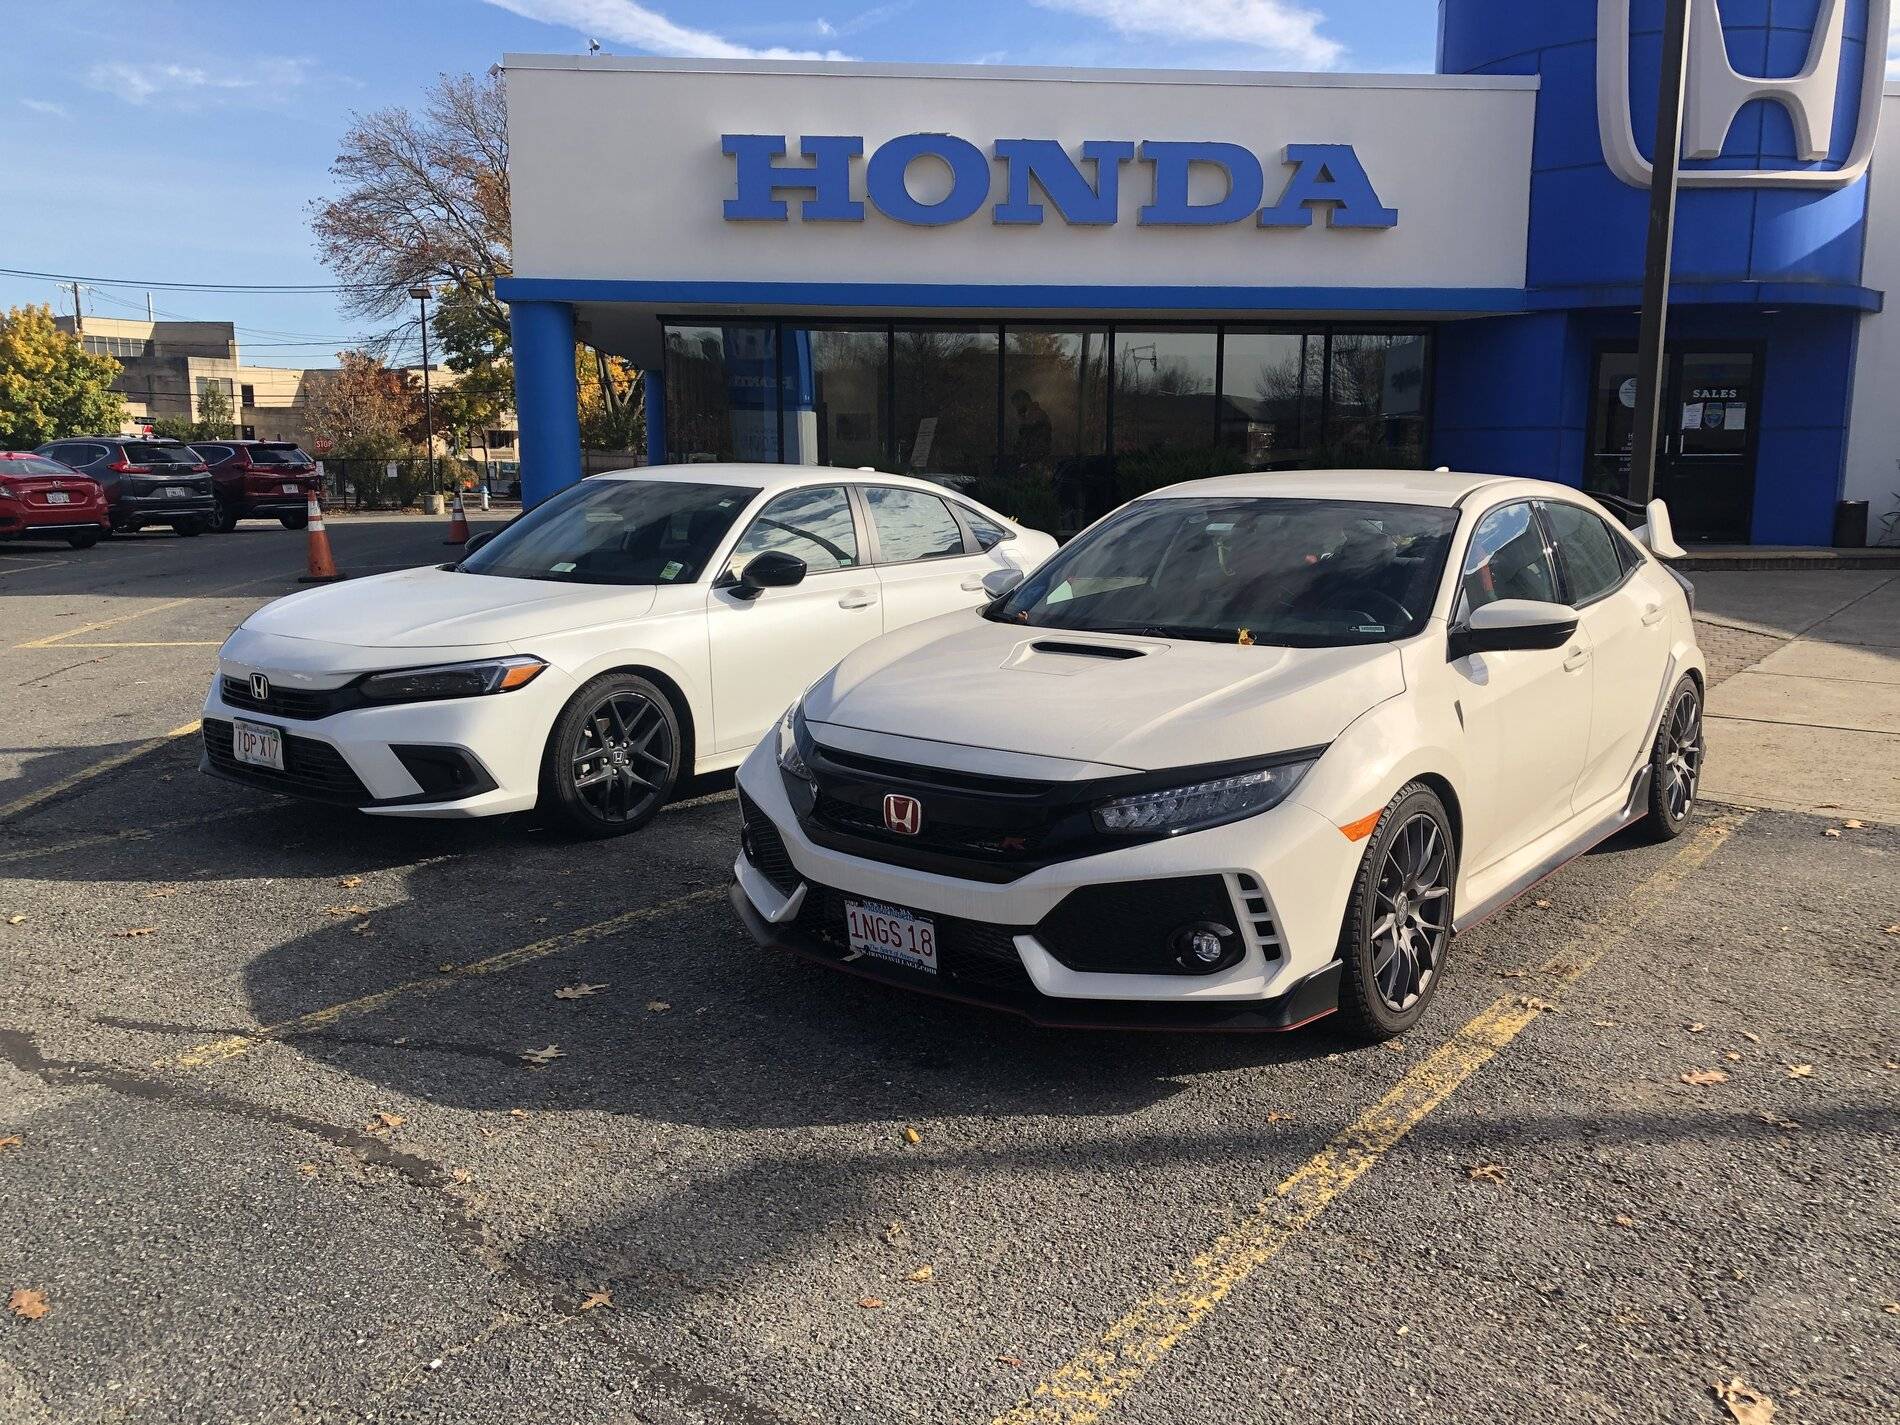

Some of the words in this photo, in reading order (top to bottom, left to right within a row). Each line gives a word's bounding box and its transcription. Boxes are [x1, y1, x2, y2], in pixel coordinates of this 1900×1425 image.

[721, 131, 1399, 230] HONDA
[1692, 388, 1738, 399] SALES
[316, 440, 333, 448] STOP
[850, 911, 903, 948] 1NGS
[907, 924, 933, 957] 18
